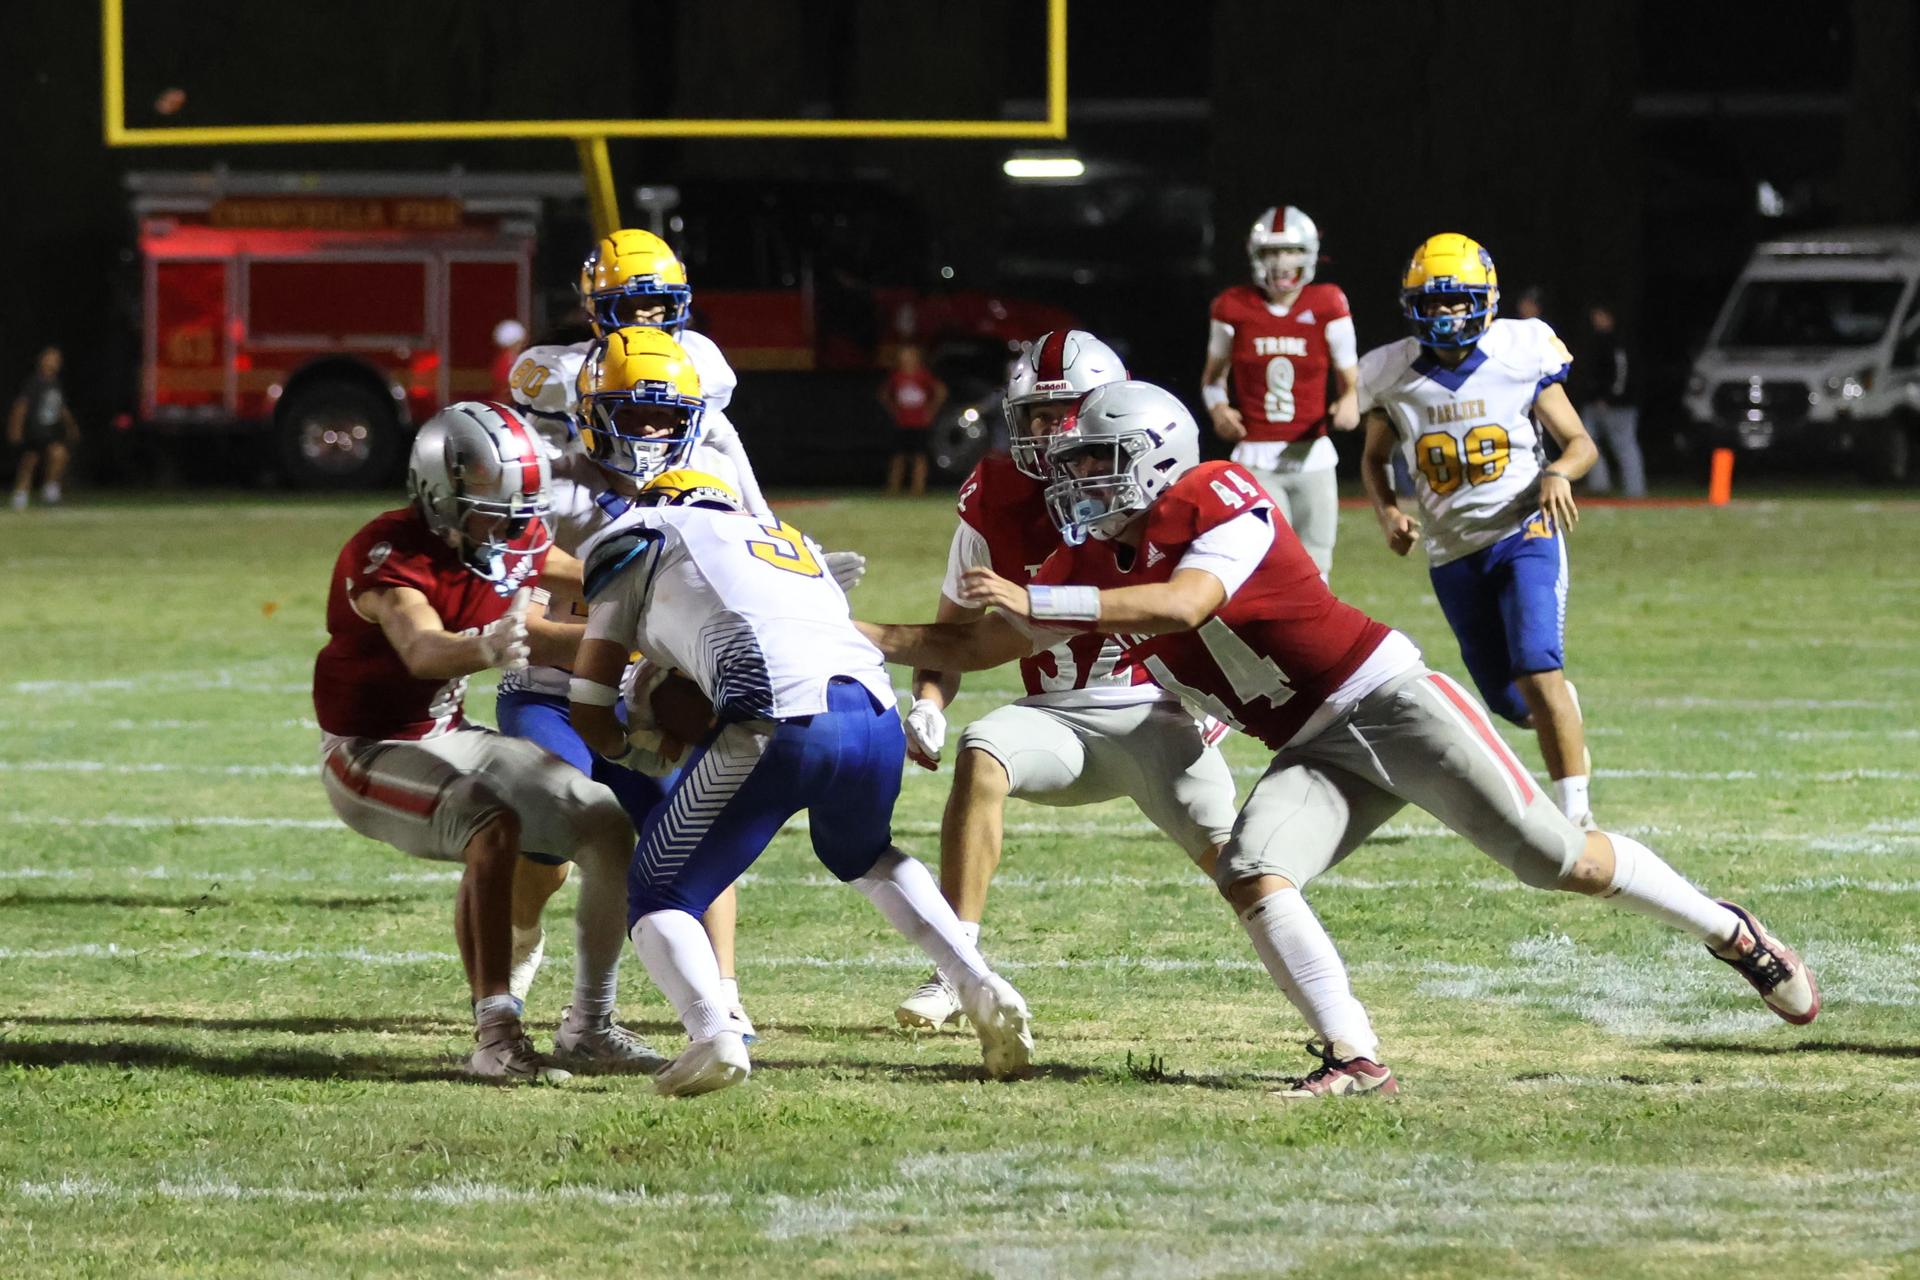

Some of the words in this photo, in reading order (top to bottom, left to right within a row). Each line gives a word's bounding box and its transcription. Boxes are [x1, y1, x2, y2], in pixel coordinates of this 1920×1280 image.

[511, 357, 551, 399] 80
[1415, 423, 1511, 496] 88
[1209, 470, 1259, 509] 44
[363, 541, 393, 575] 9
[746, 513, 824, 579] 3
